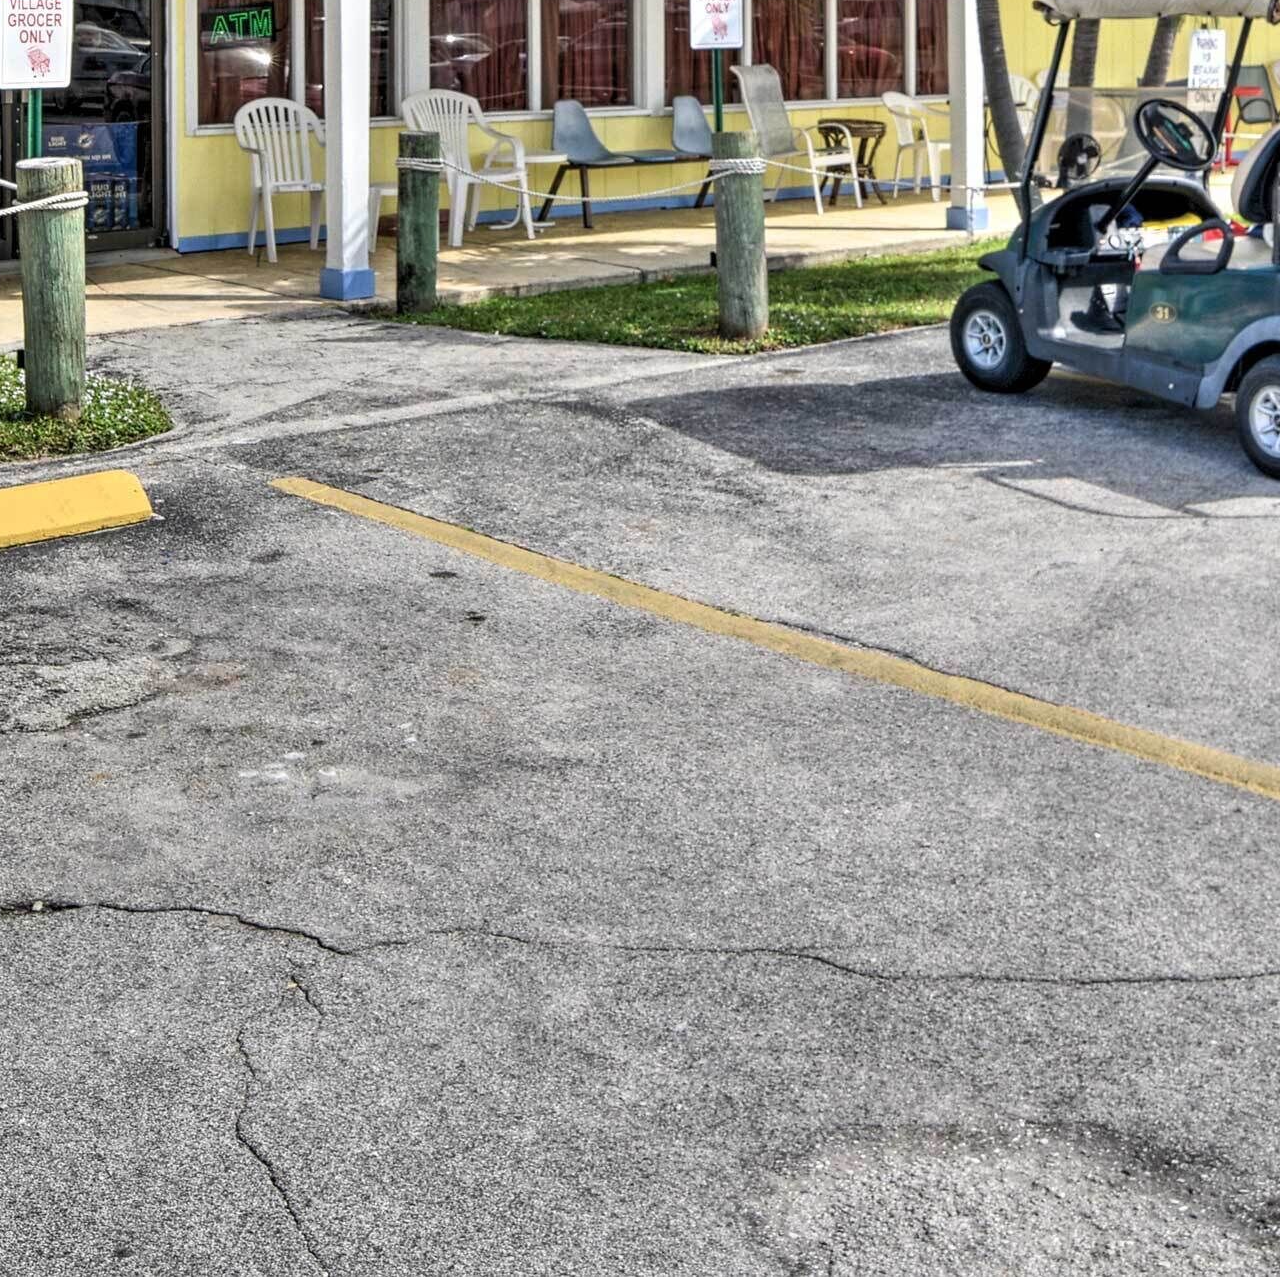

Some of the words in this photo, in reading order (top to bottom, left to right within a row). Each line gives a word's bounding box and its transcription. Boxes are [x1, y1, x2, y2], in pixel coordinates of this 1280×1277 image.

[705, 3, 730, 14] ONLY
[8, 13, 62, 27] GROCER
[210, 9, 272, 44] ATM
[19, 30, 54, 43] ONLY
[1156, 306, 1169, 320] 31
